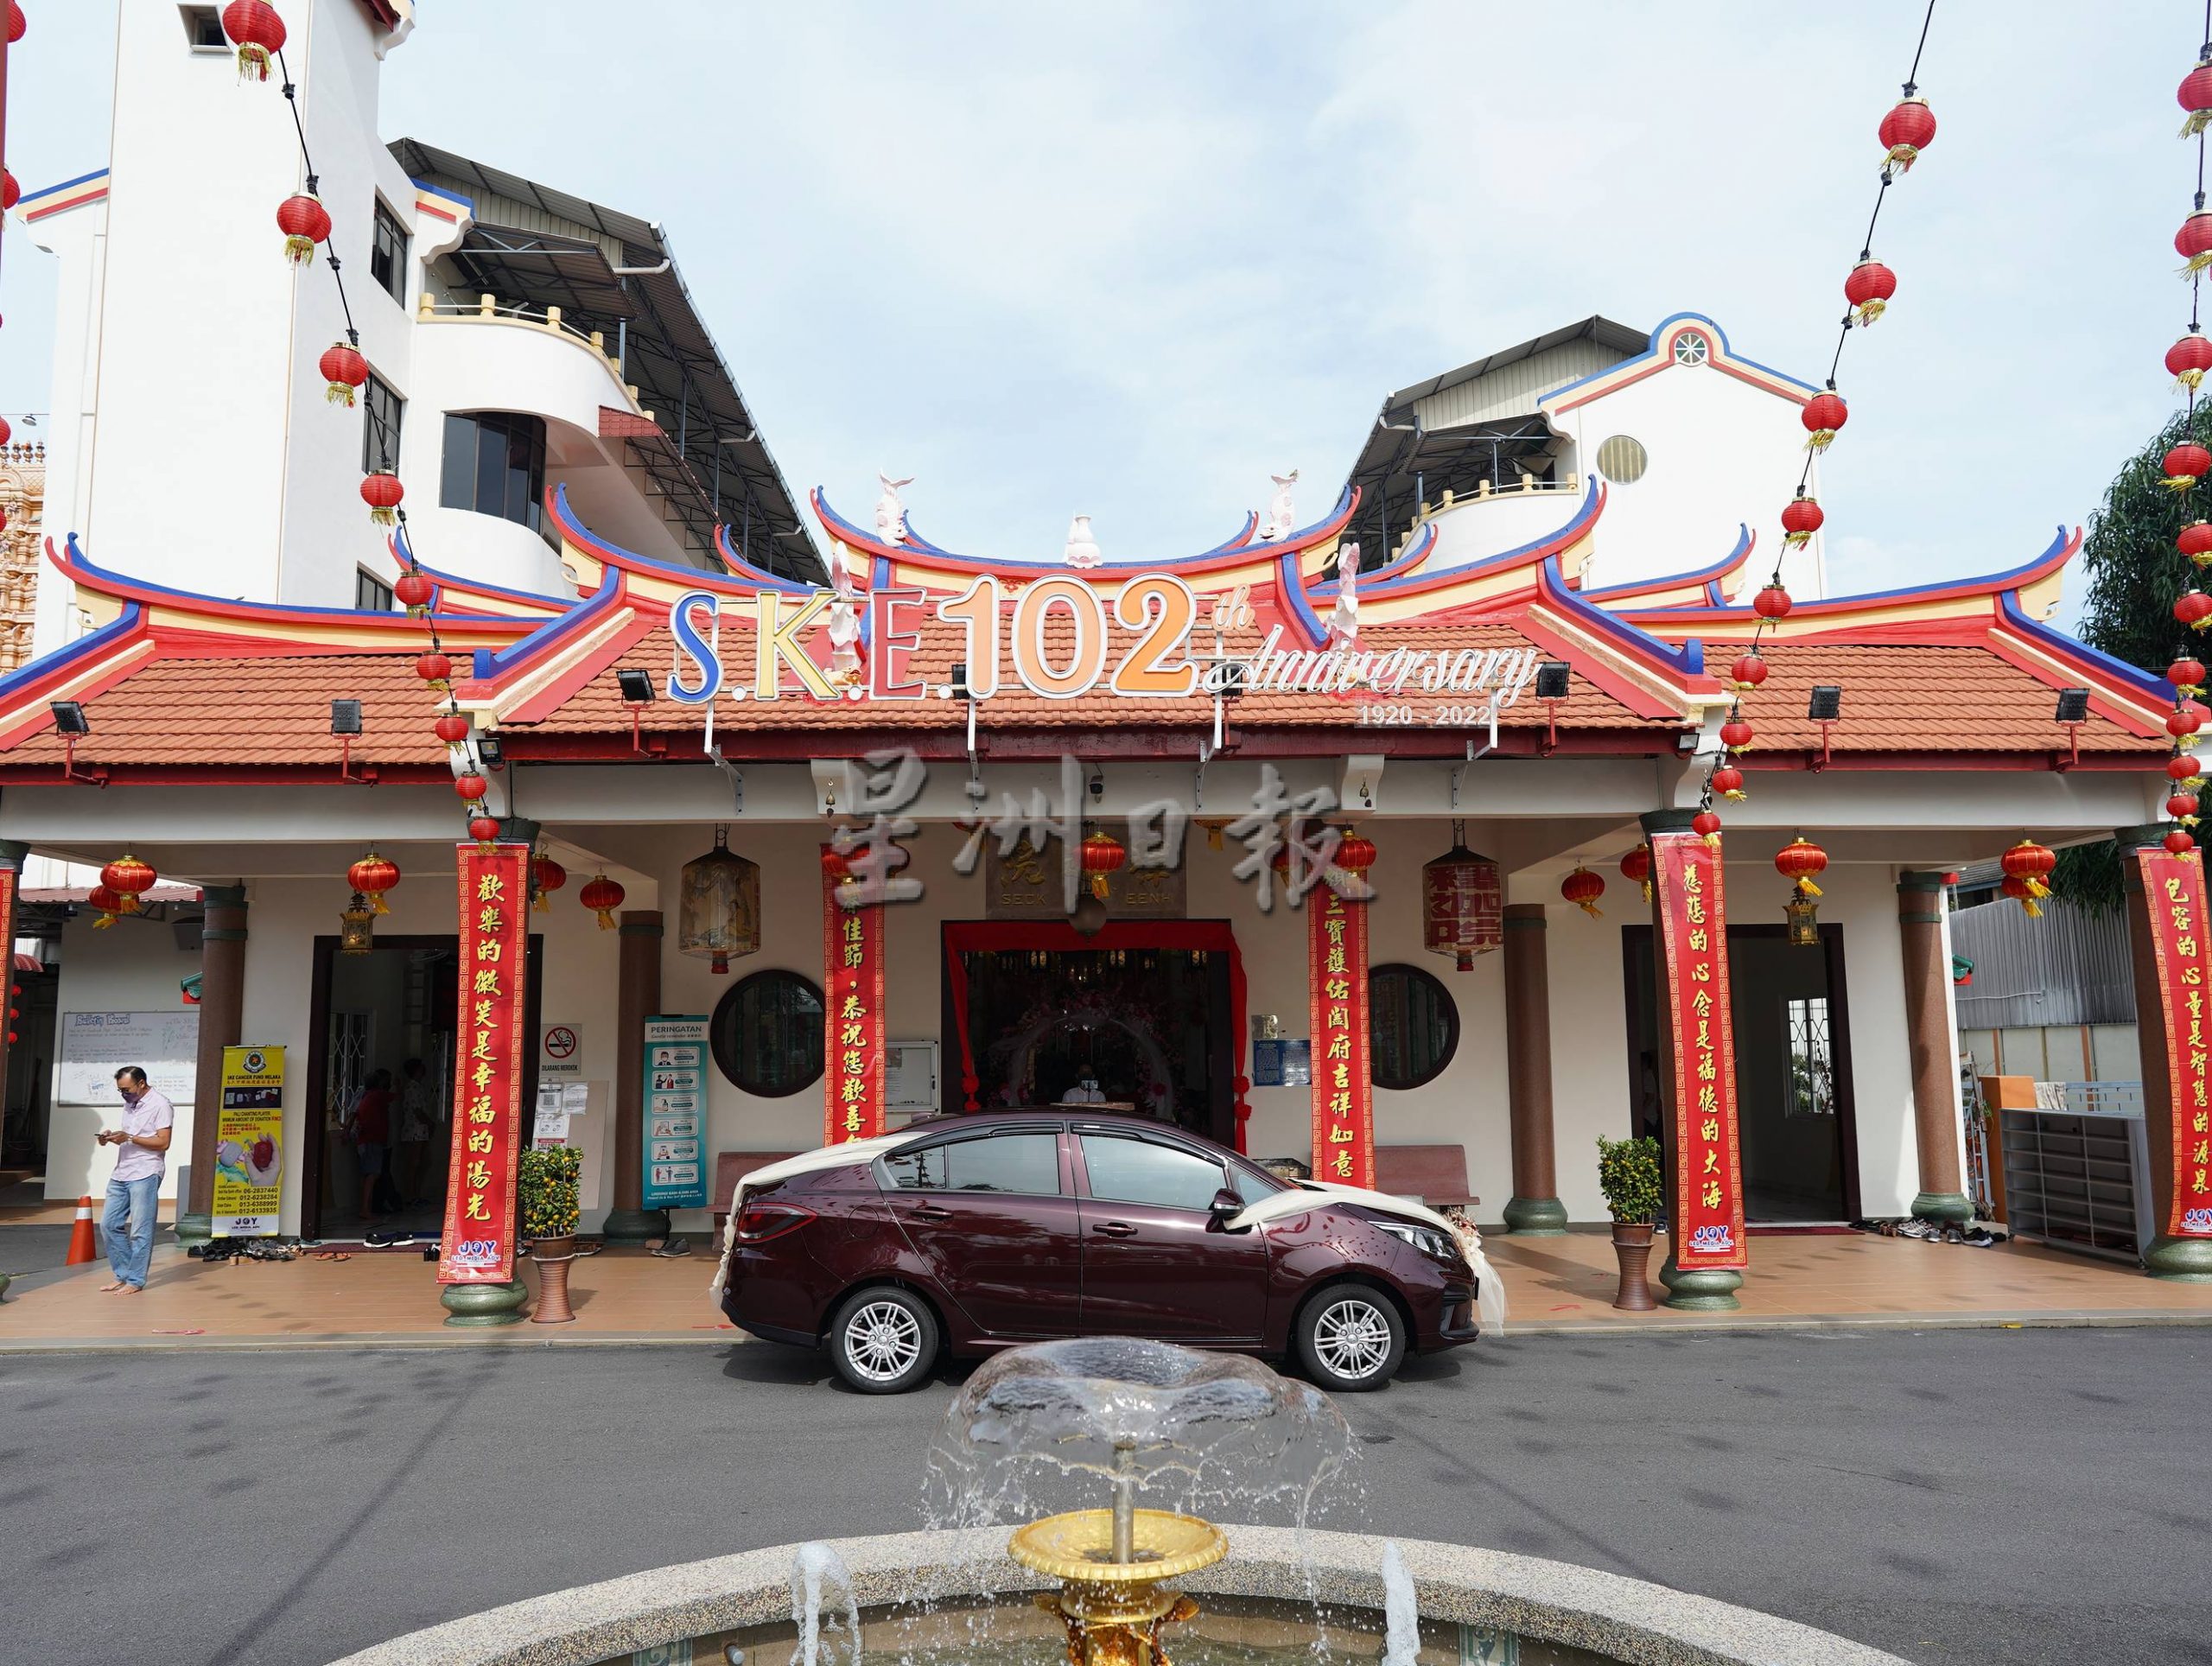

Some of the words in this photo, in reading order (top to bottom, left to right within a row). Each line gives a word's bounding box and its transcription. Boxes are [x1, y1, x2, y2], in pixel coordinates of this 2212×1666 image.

[1202, 623, 1542, 709] Anniversary
[1359, 705, 1414, 725] 1920
[1435, 705, 1491, 725] 2022
[1683, 863, 1724, 1210] 慈悲的心念是福德的大海
[2164, 877, 2210, 1194] 包容的心量是智慧的源泉
[235, 1217, 257, 1225] JOY
[1695, 1225, 1727, 1239] JOY
[459, 1241, 496, 1255] JOY
